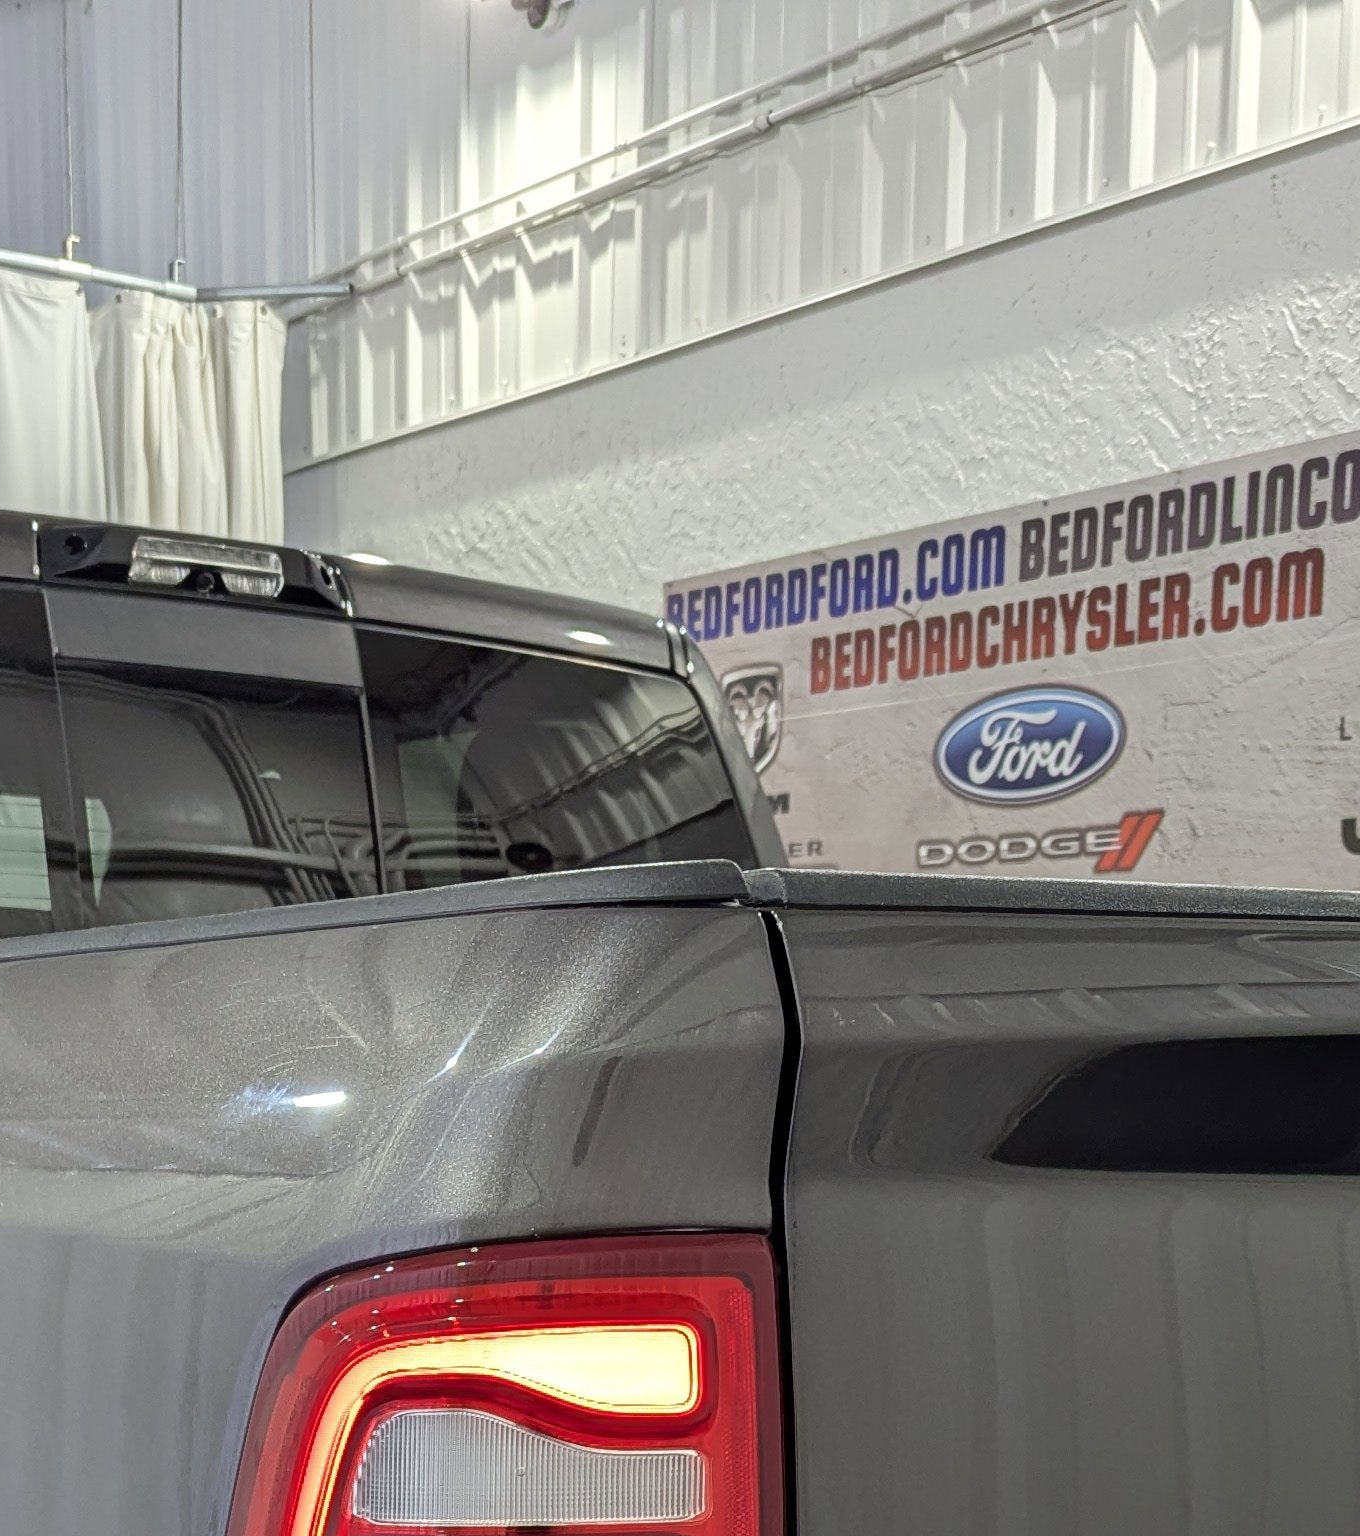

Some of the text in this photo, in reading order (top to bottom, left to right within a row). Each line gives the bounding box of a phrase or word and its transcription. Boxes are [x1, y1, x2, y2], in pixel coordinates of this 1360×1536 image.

[666, 524, 1006, 642] BEDFORDFORD.COM
[809, 546, 1325, 695] BEDFORDCHRYSLER.COM
[967, 706, 1087, 785] Ford
[915, 824, 1124, 869] DODGE
